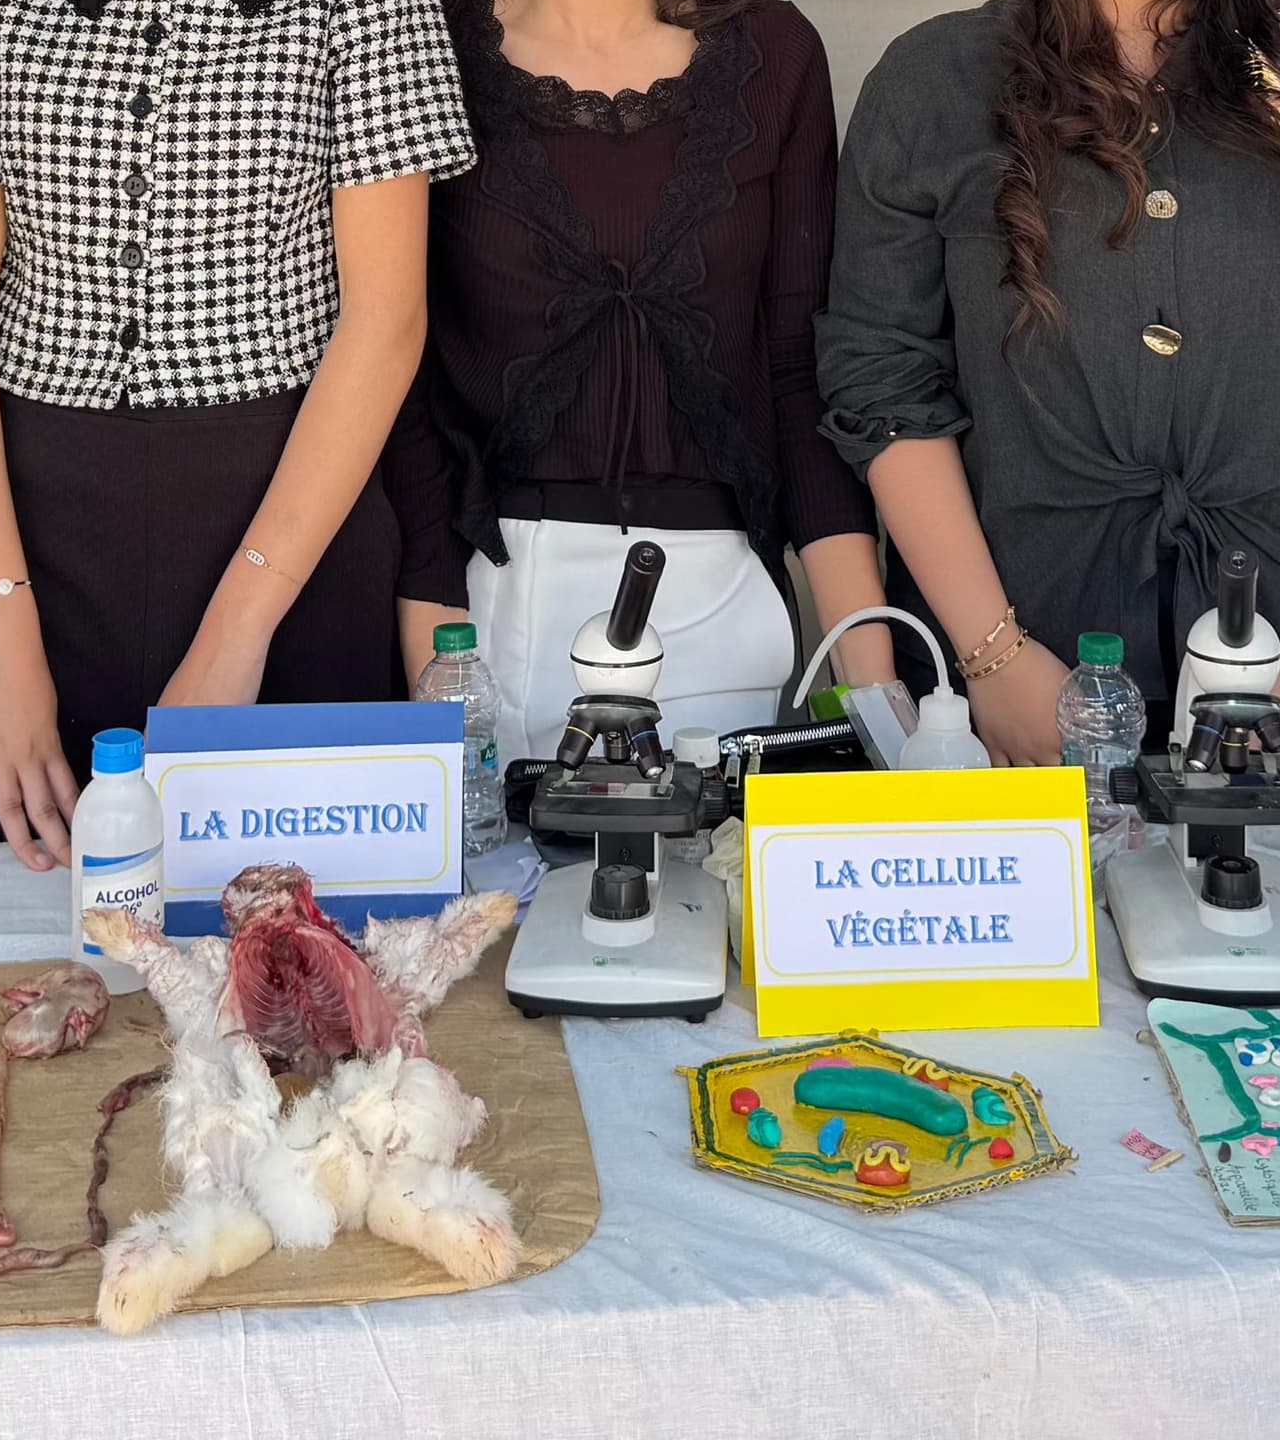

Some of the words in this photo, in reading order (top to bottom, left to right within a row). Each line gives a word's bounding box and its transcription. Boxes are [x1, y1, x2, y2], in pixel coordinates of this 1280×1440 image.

[179, 810, 230, 841] LA
[240, 802, 429, 839] DIGESTION
[814, 859, 863, 889] LA
[870, 855, 1022, 889] CELLULE
[95, 879, 160, 904] ALCOHOL
[825, 909, 1014, 948] VÉGÉTALE
